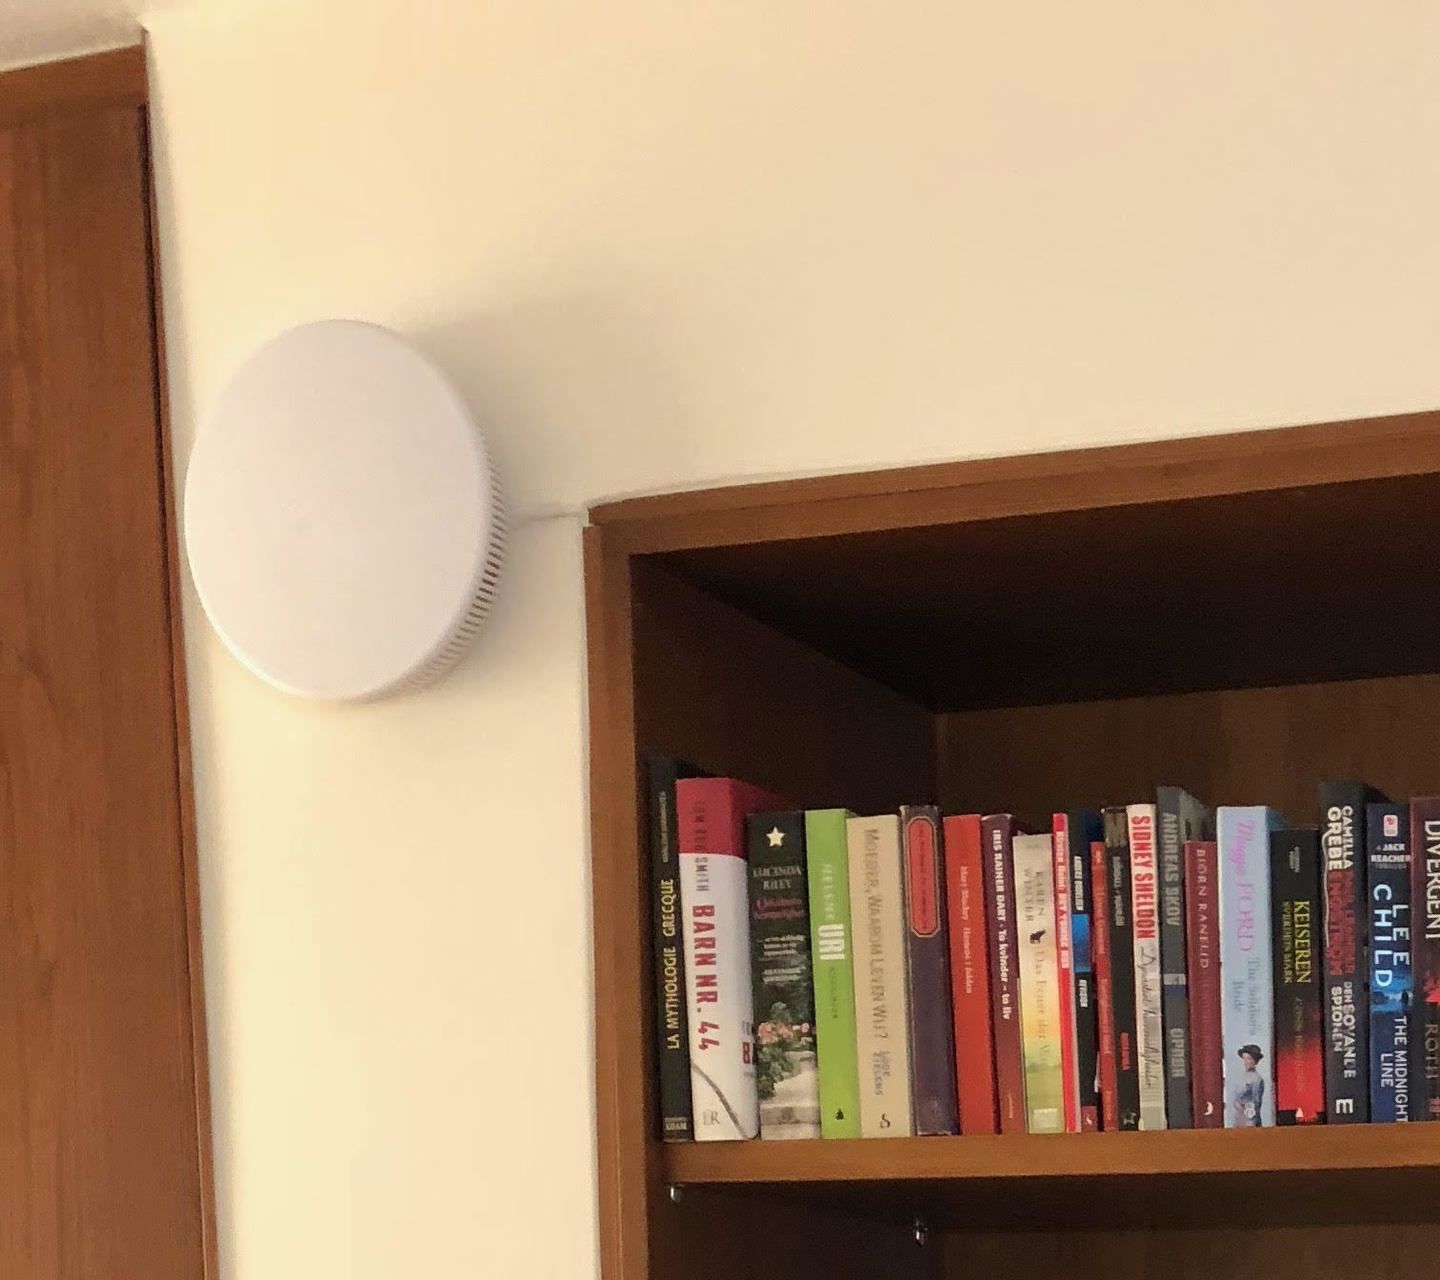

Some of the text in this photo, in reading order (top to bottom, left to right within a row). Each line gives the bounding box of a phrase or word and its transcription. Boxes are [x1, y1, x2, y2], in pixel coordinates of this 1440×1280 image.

[1162, 812, 1178, 881] ANDREAS
[1327, 806, 1342, 871] GREBE
[1342, 806, 1353, 869] CAMILLA
[992, 829, 1006, 921] IRIS RAINER DART
[1023, 867, 1036, 923] WINTER
[1131, 815, 1155, 939] SIDNEY SHELDON
[1234, 820, 1257, 952] Maggie FORD
[660, 879, 680, 1049] LA MYTHOLOGIE GRECQUE
[818, 924, 845, 961] URI
[998, 944, 1010, 982] kvinder
[1197, 903, 1210, 969] RANELID
[1293, 900, 1311, 984] KEISEREN
[1374, 884, 1392, 987] CHILD
[1392, 904, 1410, 966] LEE
[692, 905, 720, 1051] BARN NR. 44
[1380, 1053, 1394, 1087] LINE
[1394, 1016, 1408, 1122] THE MIDNIGHT
[1424, 1023, 1440, 1079] ROTH
